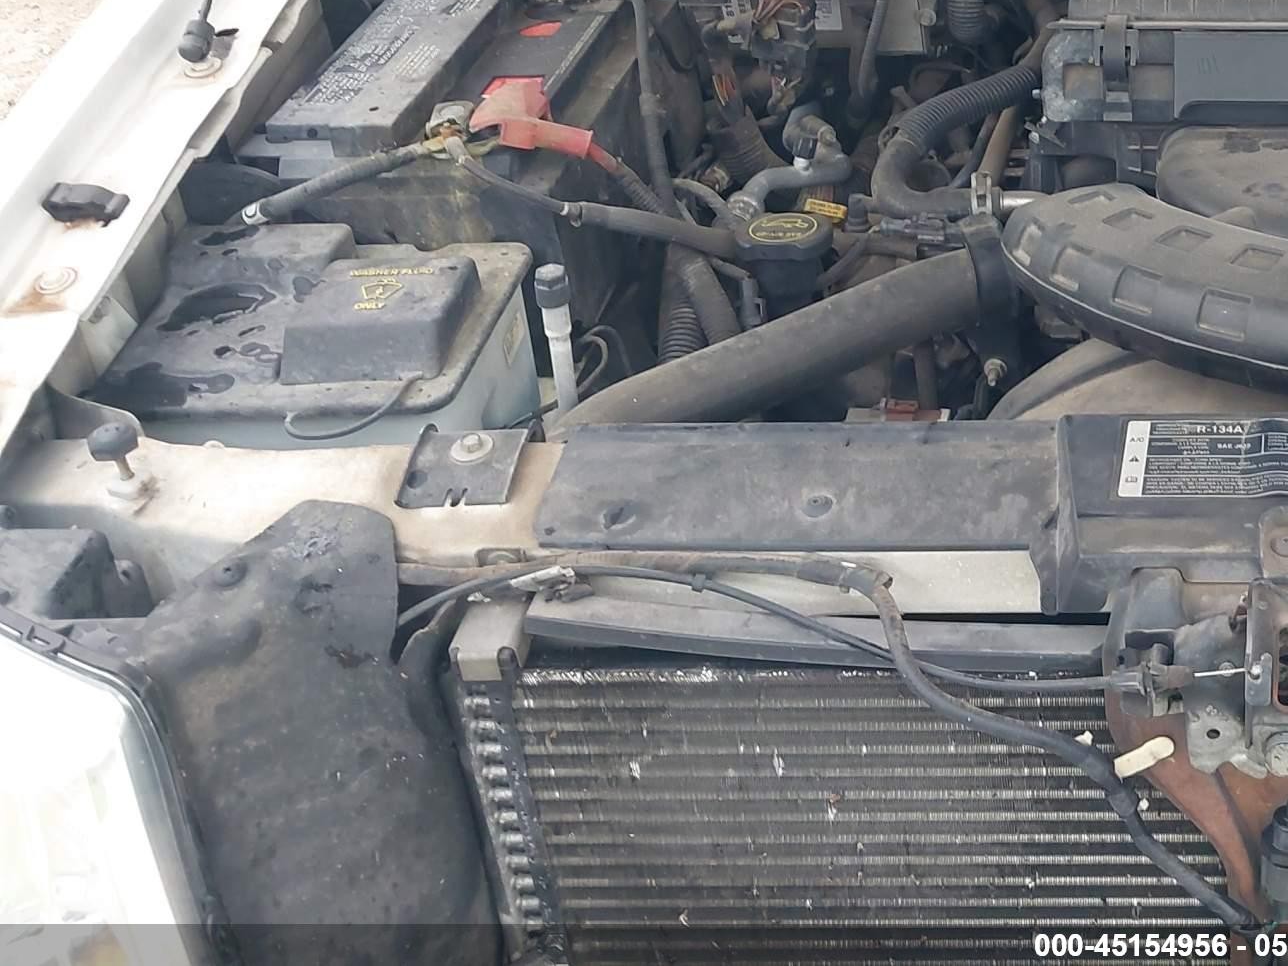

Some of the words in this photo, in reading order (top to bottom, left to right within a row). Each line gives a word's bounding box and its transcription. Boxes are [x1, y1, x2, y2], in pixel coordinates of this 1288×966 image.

[350, 268, 398, 277] WASHER
[400, 266, 433, 276] FLUID
[354, 299, 386, 310] ONLY
[1196, 424, 1244, 434] R-134A
